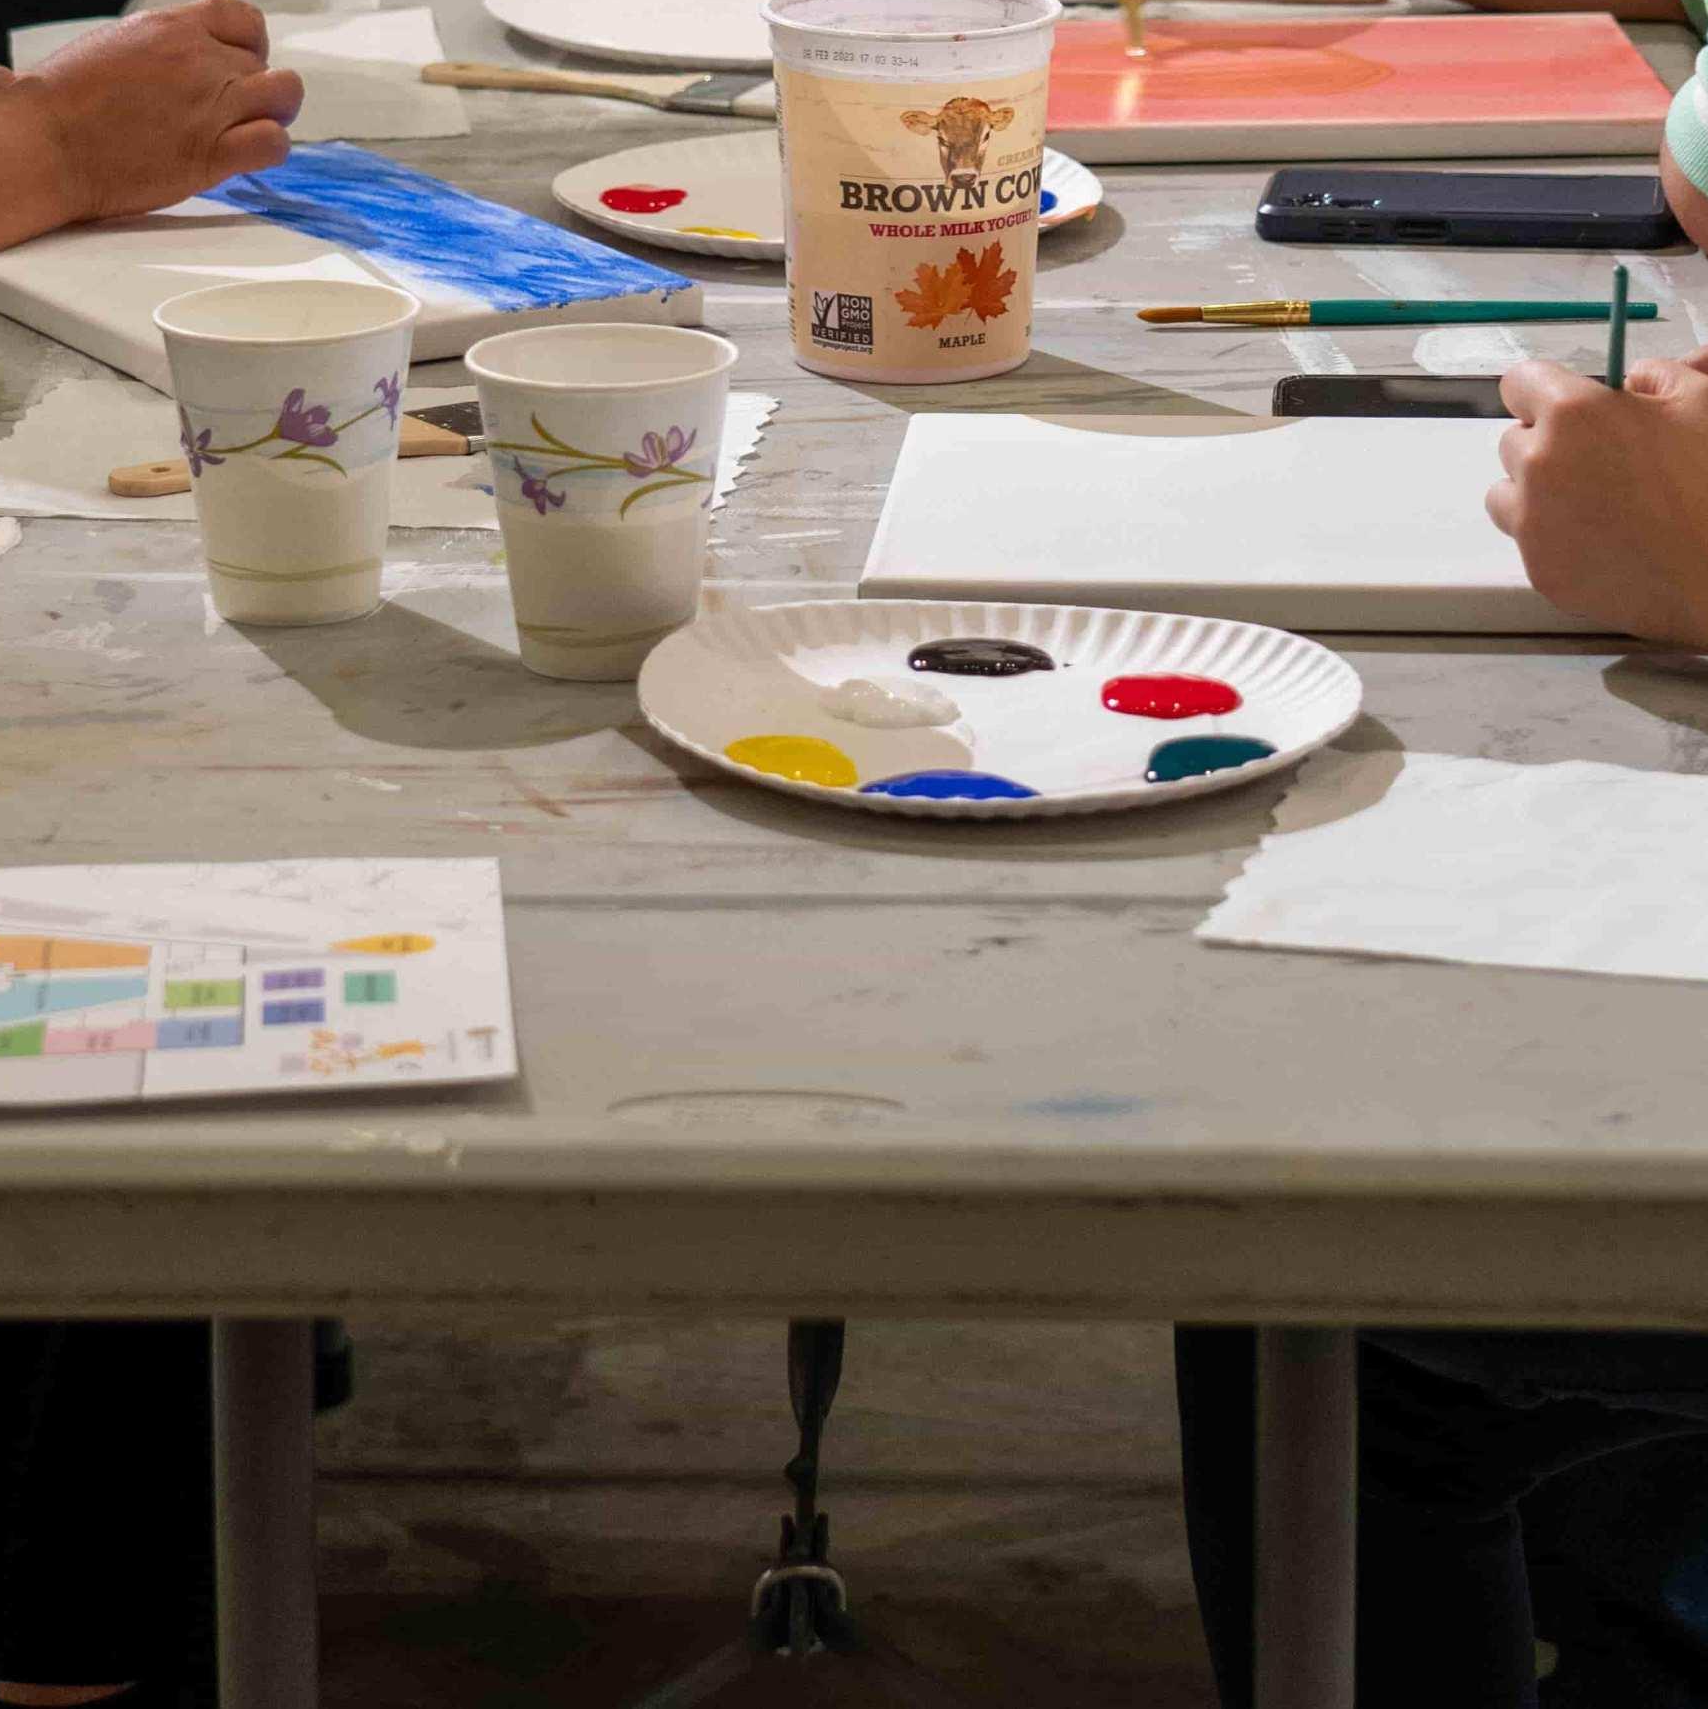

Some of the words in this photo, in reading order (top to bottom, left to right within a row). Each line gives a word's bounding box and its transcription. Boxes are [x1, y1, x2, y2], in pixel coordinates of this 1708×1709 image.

[839, 180, 989, 213] BROWN
[868, 223, 936, 238] WHOLE
[939, 220, 985, 237] MILK
[840, 296, 870, 309] NON
[841, 308, 870, 321] GMO
[814, 326, 870, 344] VERIFIED
[938, 333, 987, 348] MAPLE
